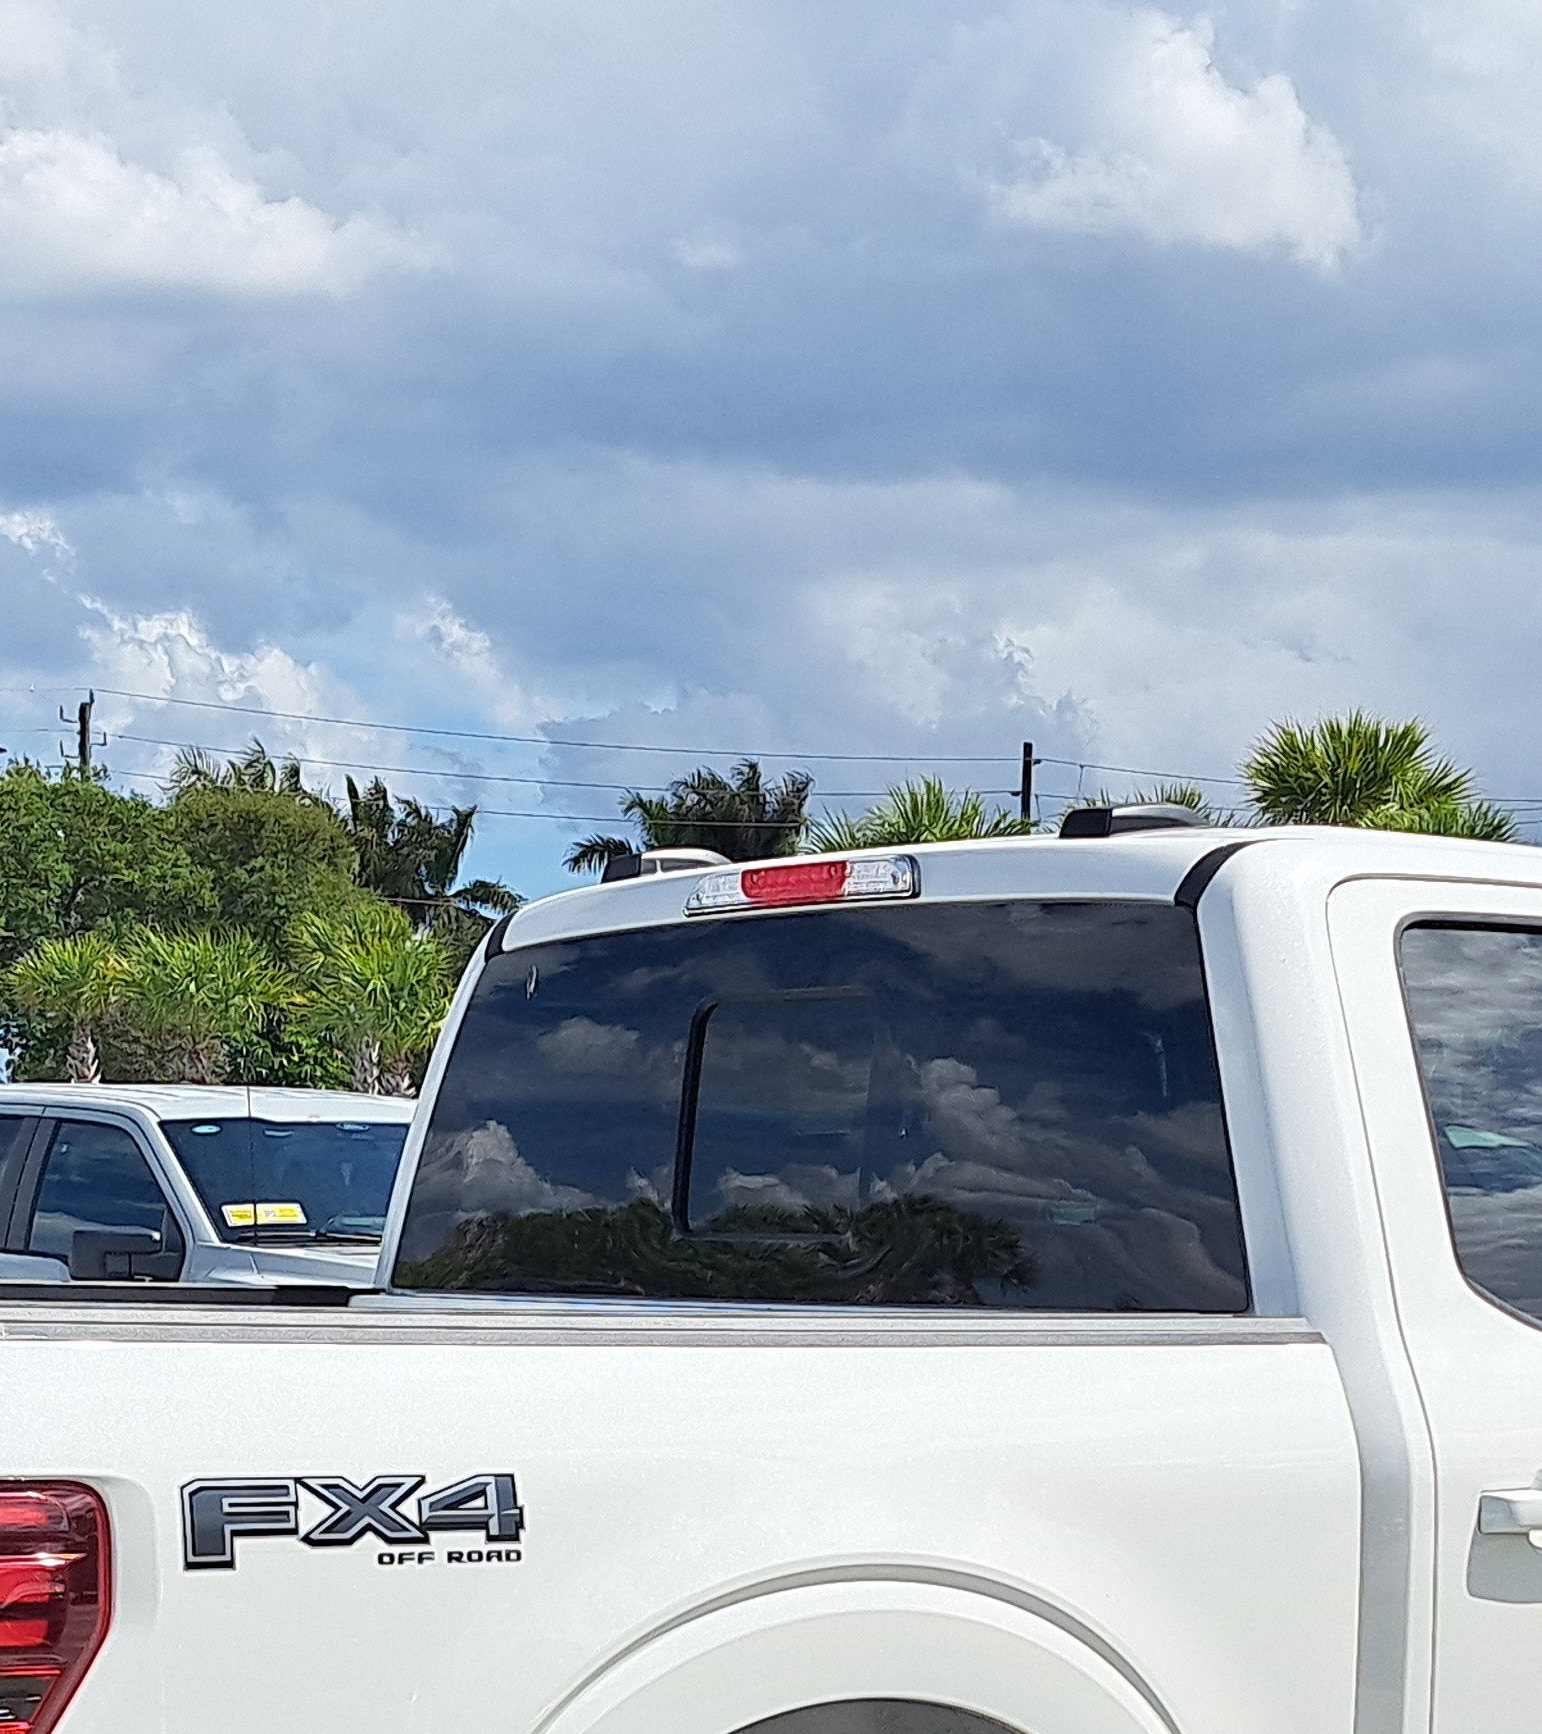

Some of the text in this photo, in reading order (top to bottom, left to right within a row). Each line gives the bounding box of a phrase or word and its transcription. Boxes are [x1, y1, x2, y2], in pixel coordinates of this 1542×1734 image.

[180, 1473, 525, 1571] FX4
[377, 1549, 523, 1566] OFF ROAD
